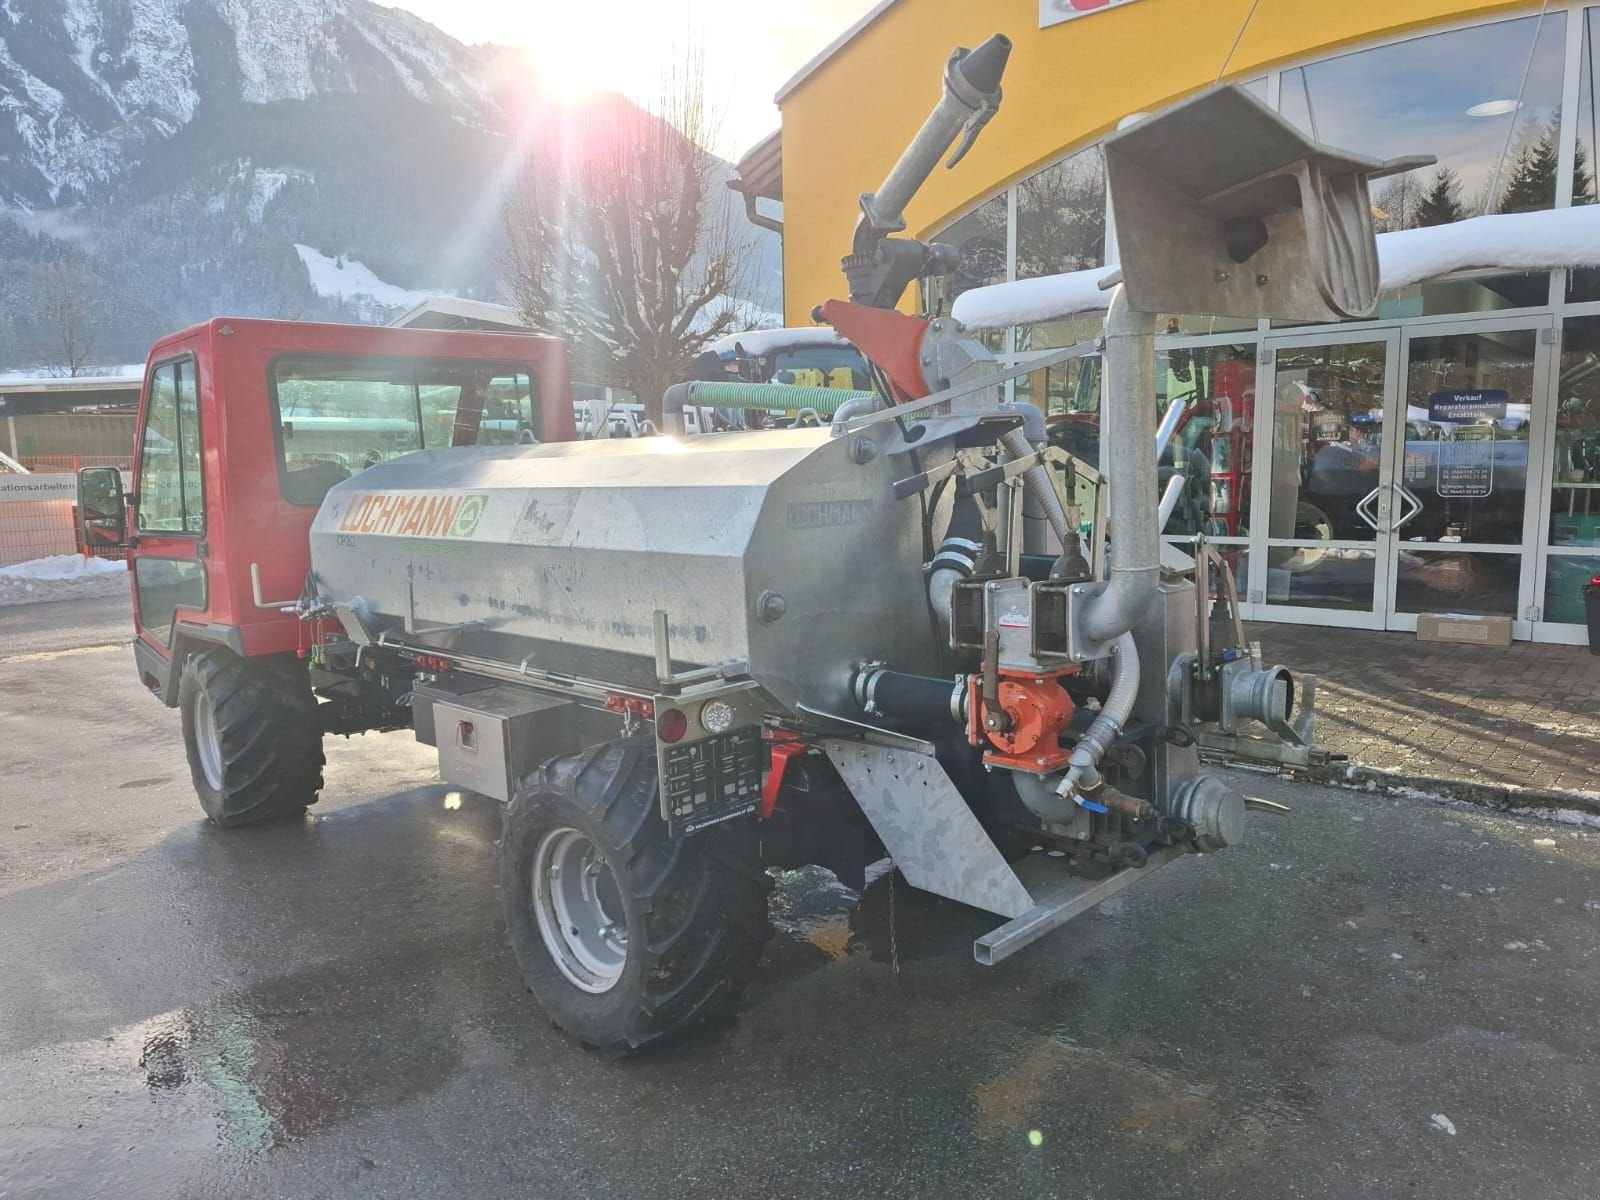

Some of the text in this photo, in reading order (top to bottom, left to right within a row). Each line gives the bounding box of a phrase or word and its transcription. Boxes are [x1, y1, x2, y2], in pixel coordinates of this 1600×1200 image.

[1453, 393, 1482, 402] Verkauf
[1434, 402, 1502, 411] Reparaturannahme
[1447, 411, 1486, 419] Ersatzteile
[339, 494, 463, 537] LOCHMANN
